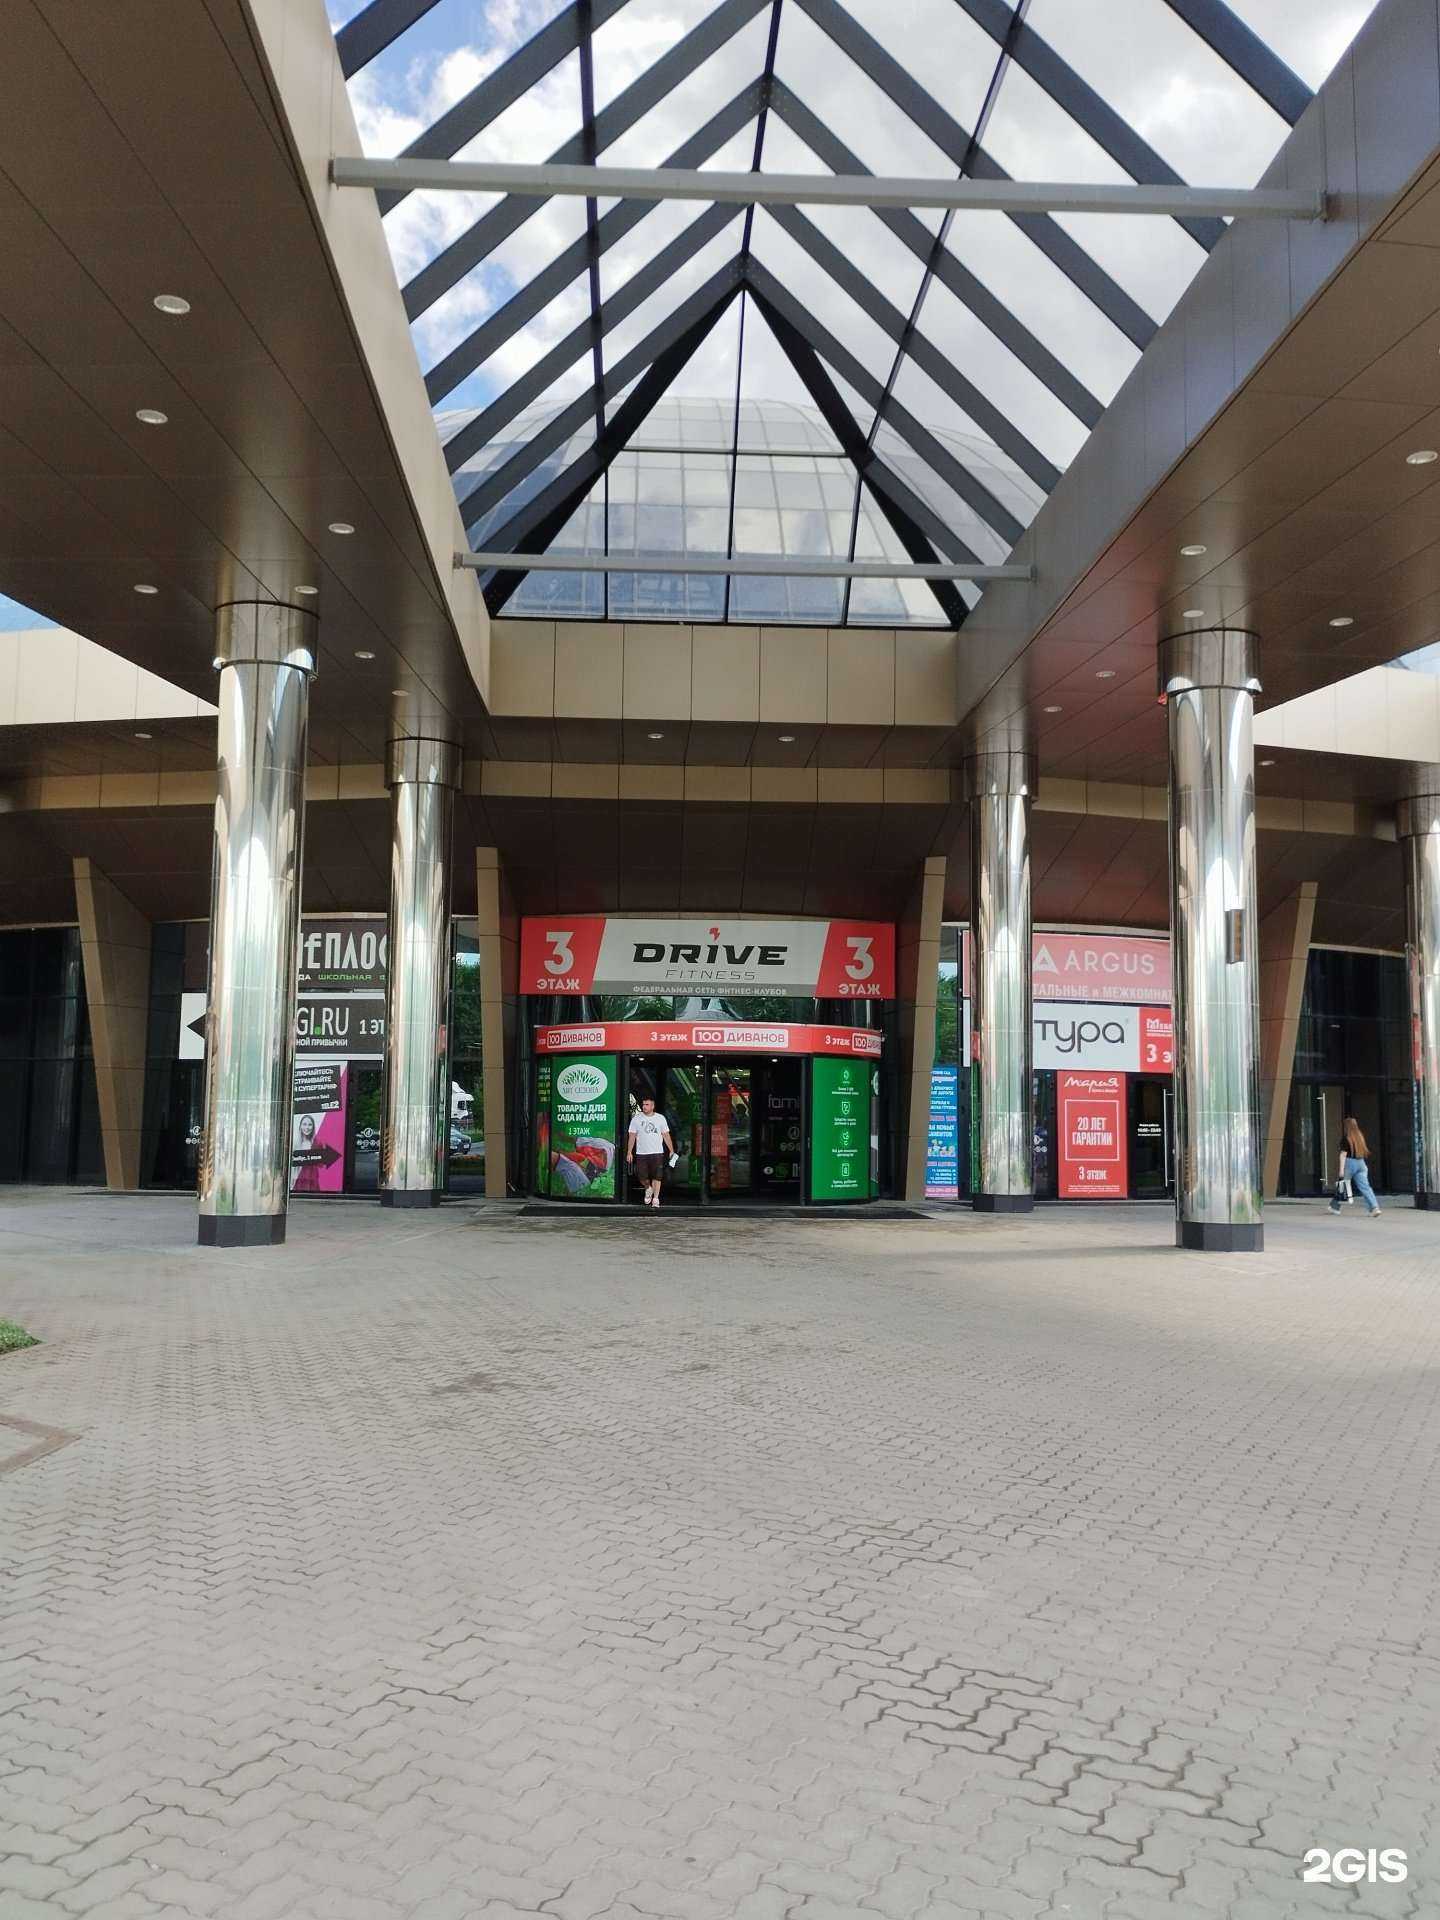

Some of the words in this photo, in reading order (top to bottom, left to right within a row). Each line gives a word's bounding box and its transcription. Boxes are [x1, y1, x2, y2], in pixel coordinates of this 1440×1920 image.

[300, 931, 387, 970] ЕПЛО
[543, 931, 576, 975] 3
[632, 937, 788, 966] DRIVE
[844, 936, 875, 981] 3
[1064, 949, 1155, 975] ARGUS
[318, 973, 372, 981] ШКОЛЬНАЯ
[665, 968, 757, 980] FITNESS
[536, 978, 580, 990] ЭТАЖ
[838, 983, 881, 995] ЭТАЖ
[632, 985, 694, 994] ФЕДЕРАЛЬНАЯ
[695, 986, 715, 995] СЕТЬ
[717, 986, 787, 996] ФИТНЕС-КЛУБОВ
[359, 1019, 368, 1035] 1
[311, 1038, 348, 1047] ПРИВЫЧКИ
[562, 1032, 602, 1044] ДИВАНОВ
[650, 1032, 657, 1041] 3
[659, 1032, 687, 1041] этаж
[699, 1031, 722, 1042] 100
[726, 1032, 785, 1043] ДИВАНОВ
[1146, 1043, 1158, 1063] 3
[557, 1104, 587, 1112] ТОВАРЫ
[588, 1104, 607, 1113] ДЛЯ
[557, 1114, 575, 1123] САДА
[583, 1113, 607, 1122] ДАЧИ
[1077, 1117, 1089, 1131] 20
[1090, 1117, 1107, 1131] ЛЕТ
[572, 1127, 591, 1135] ЭТАЖ
[1072, 1132, 1112, 1146] ГАРАНТИИ
[1079, 1166, 1085, 1180] 3
[1086, 1169, 1107, 1180] этаж
